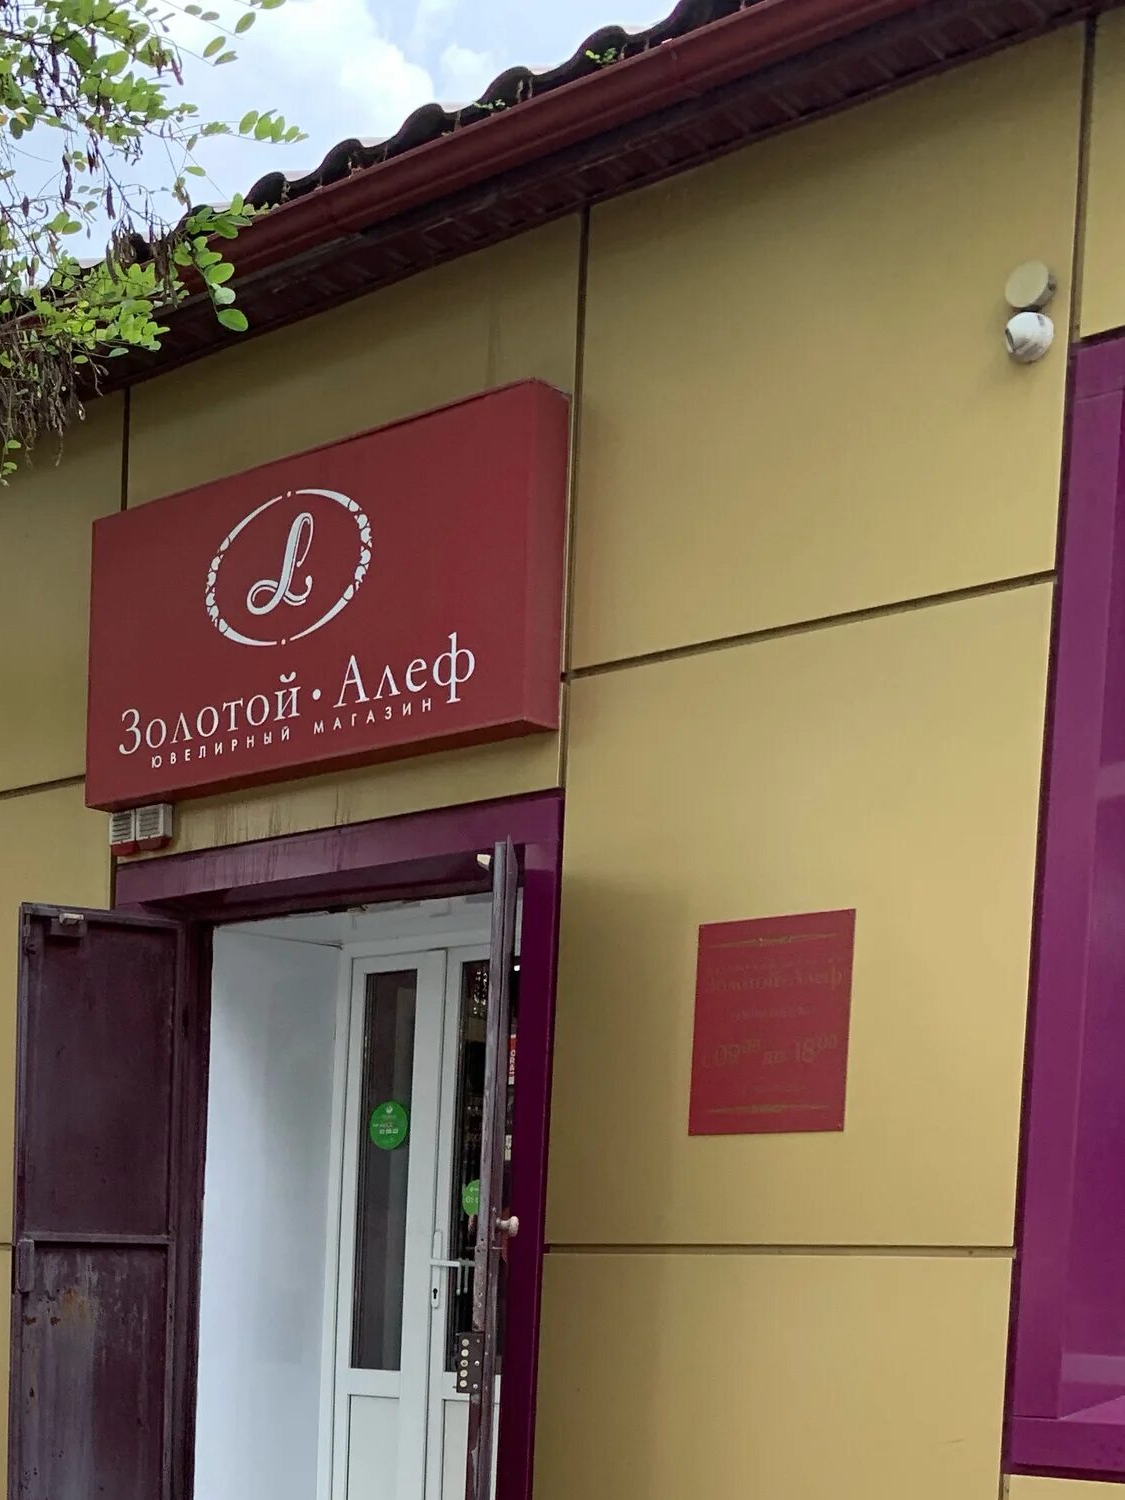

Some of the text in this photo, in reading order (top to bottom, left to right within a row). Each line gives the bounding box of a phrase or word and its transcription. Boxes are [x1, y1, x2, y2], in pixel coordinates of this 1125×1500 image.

[118, 632, 476, 755] Золотой Алеф
[150, 698, 433, 769] ЮВЕЛИРНЫЙ МАГАЗИН
